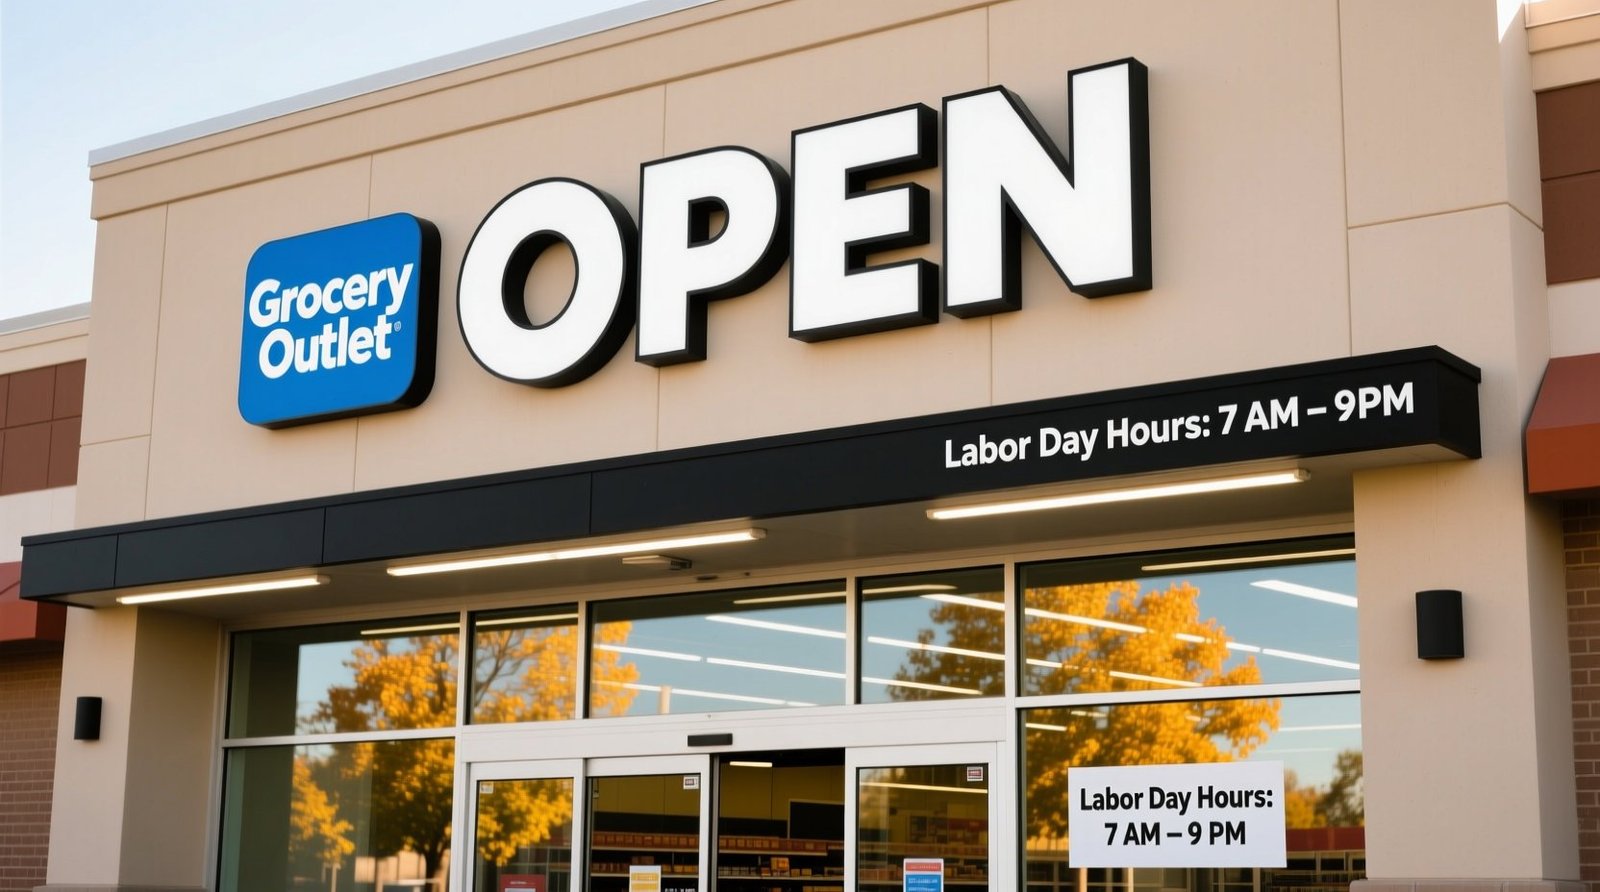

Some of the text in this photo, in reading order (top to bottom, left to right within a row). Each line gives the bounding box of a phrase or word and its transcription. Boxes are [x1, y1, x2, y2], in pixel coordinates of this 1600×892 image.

[456, 57, 1151, 388] OPEN
[248, 262, 414, 328] Grocery
[945, 434, 1032, 469] Labor
[1039, 421, 1099, 462] Day
[1107, 413, 1211, 449] Hours:
[1218, 404, 1238, 435] 7
[1243, 396, 1299, 433] AM
[1334, 381, 1415, 422] 9PM
[1080, 785, 1274, 816] Labor Day Hours:
[1104, 822, 1118, 846] 7
[1122, 821, 1161, 846] AM
[1187, 821, 1203, 846] 9
[1209, 820, 1246, 846] PM
